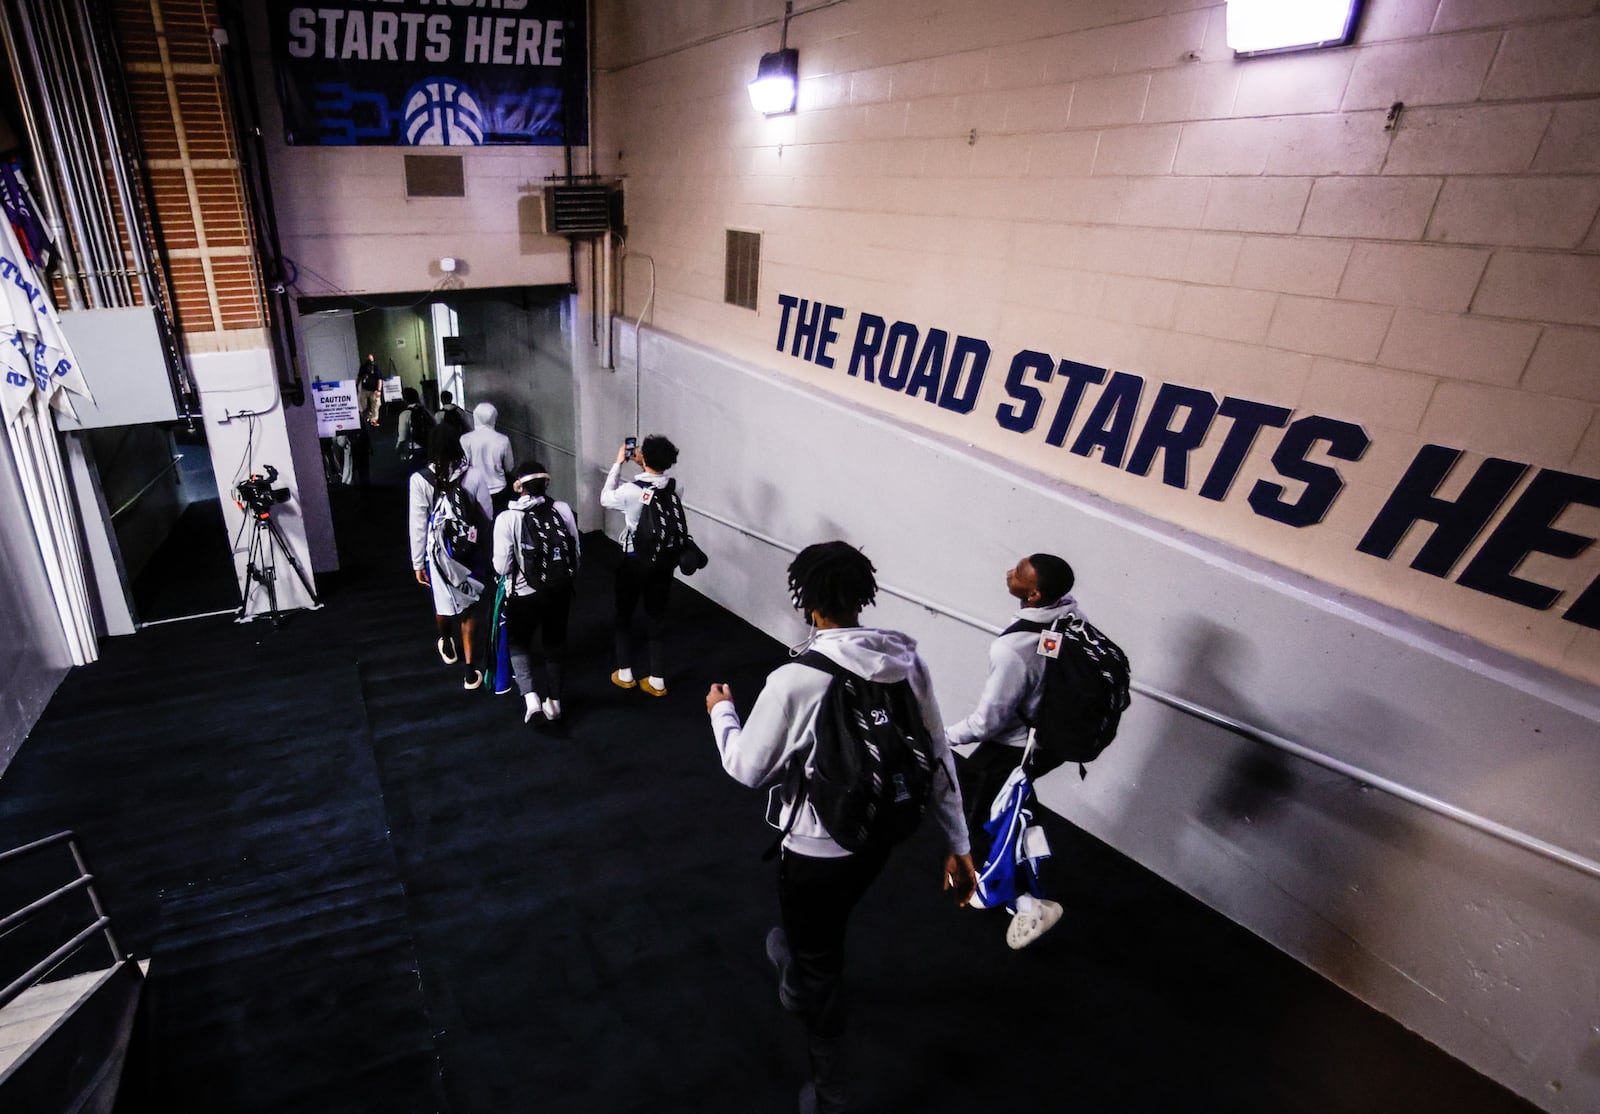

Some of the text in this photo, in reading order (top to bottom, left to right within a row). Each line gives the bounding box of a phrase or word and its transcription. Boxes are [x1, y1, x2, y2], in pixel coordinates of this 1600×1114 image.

[288, 8, 563, 66] STARTS HERE
[320, 395, 351, 403] CAUTION
[776, 294, 1600, 632] THE ROAD STARTS HE
[870, 709, 888, 725] 23
